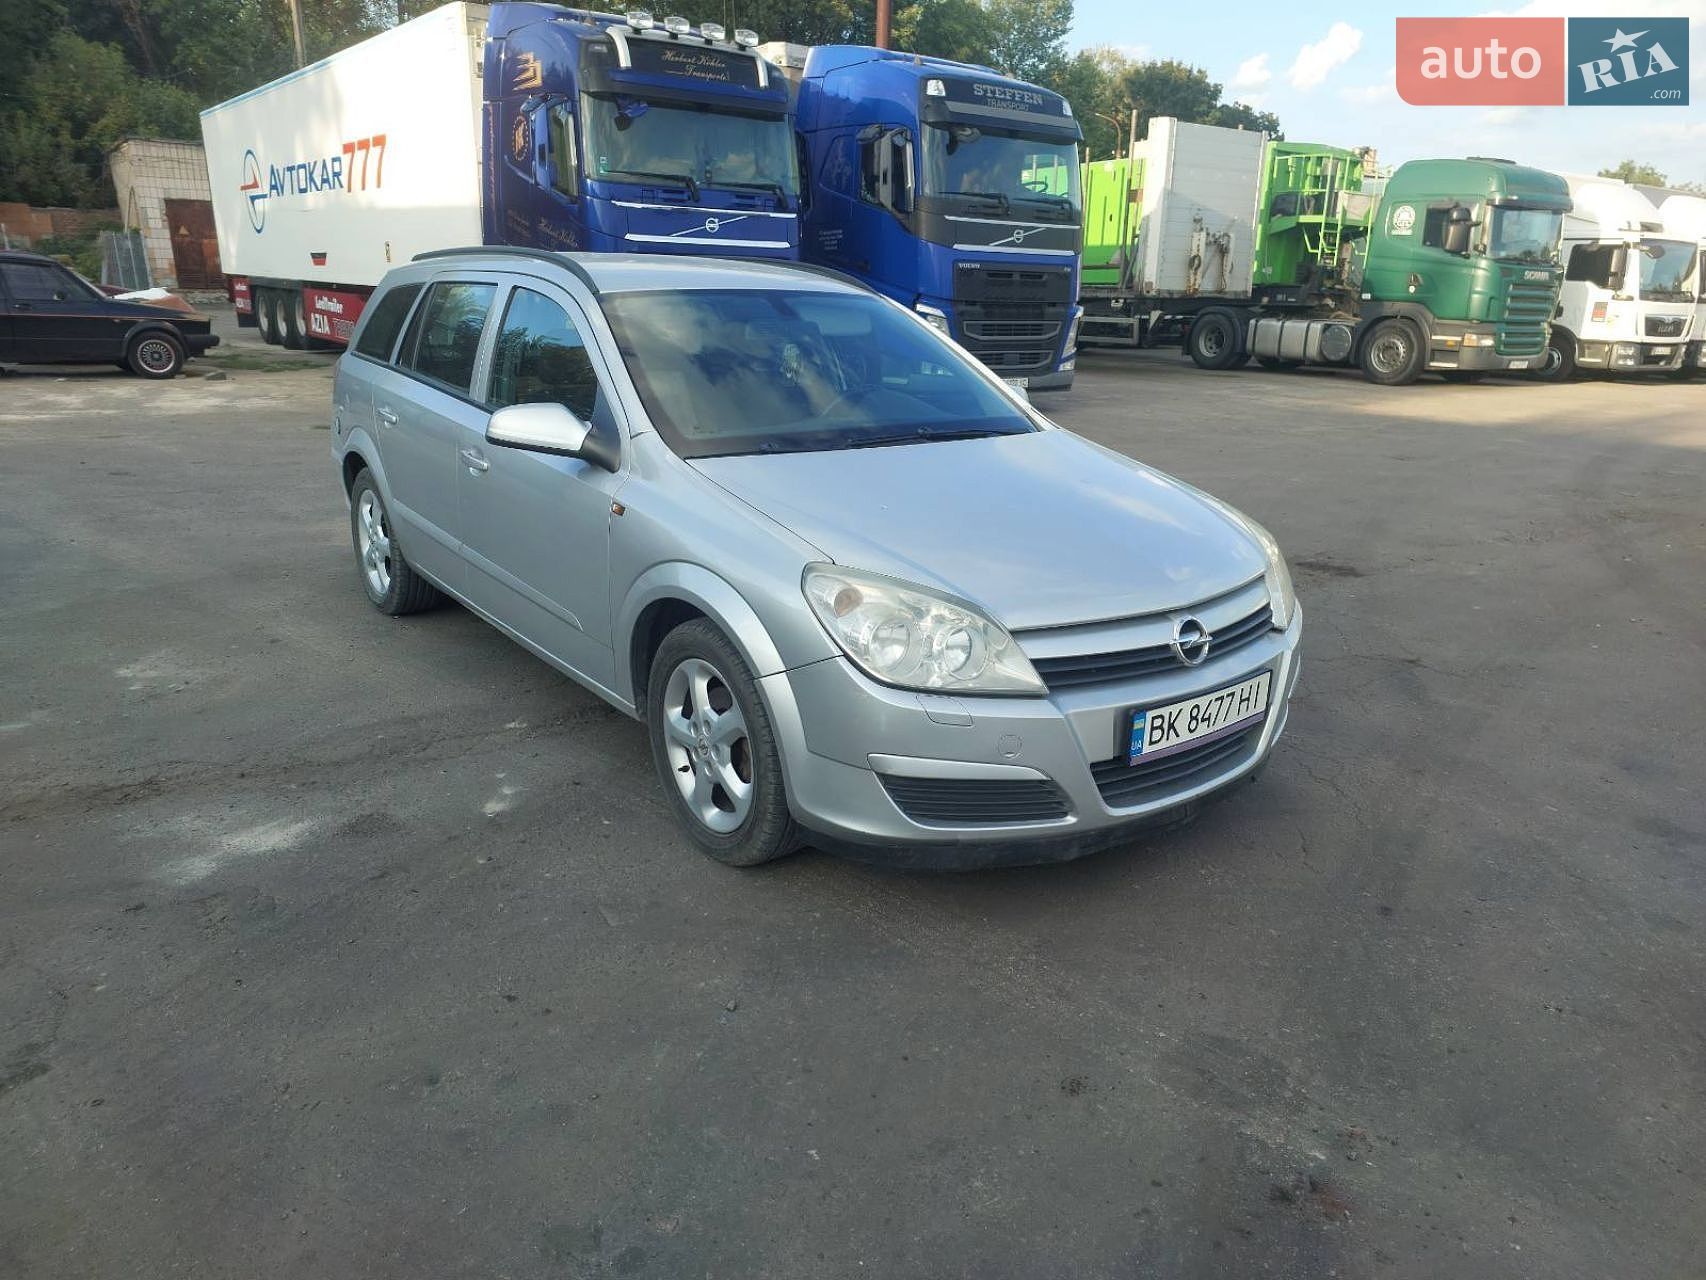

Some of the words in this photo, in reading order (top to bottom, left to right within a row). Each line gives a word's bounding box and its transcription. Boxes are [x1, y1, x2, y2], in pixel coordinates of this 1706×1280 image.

[973, 83, 1043, 105] STEFFEN
[1130, 740, 1142, 751] UA
[1148, 708, 1184, 747] BK
[1187, 691, 1235, 733] 8477
